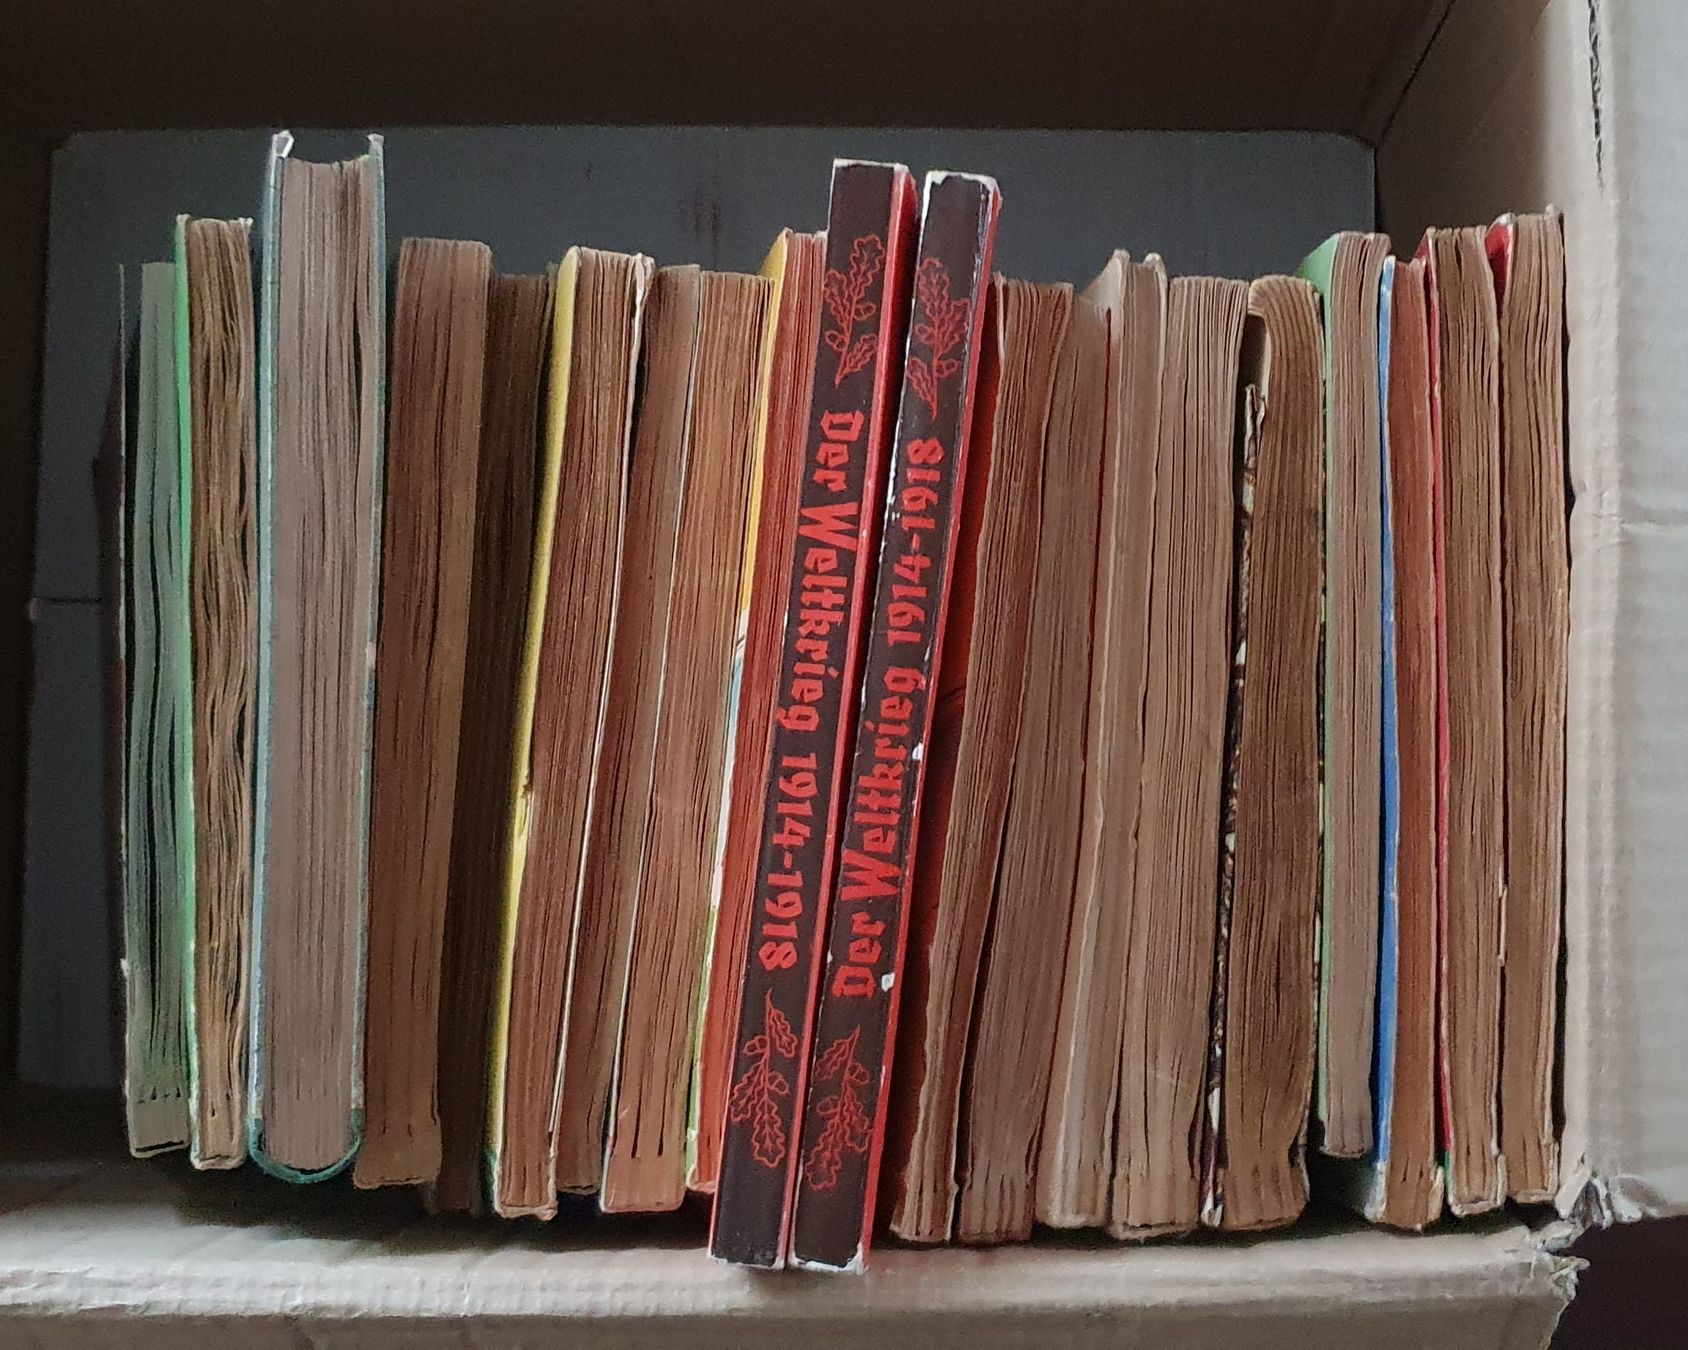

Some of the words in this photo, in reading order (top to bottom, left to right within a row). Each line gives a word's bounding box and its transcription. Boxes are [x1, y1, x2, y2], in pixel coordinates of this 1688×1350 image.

[812, 409, 865, 493] Der
[885, 437, 945, 647] 1914-1918
[777, 502, 859, 732] Weltkrieg
[757, 753, 820, 972] 1914-1918
[841, 666, 926, 901] Weltkrieg
[830, 911, 887, 998] Der
